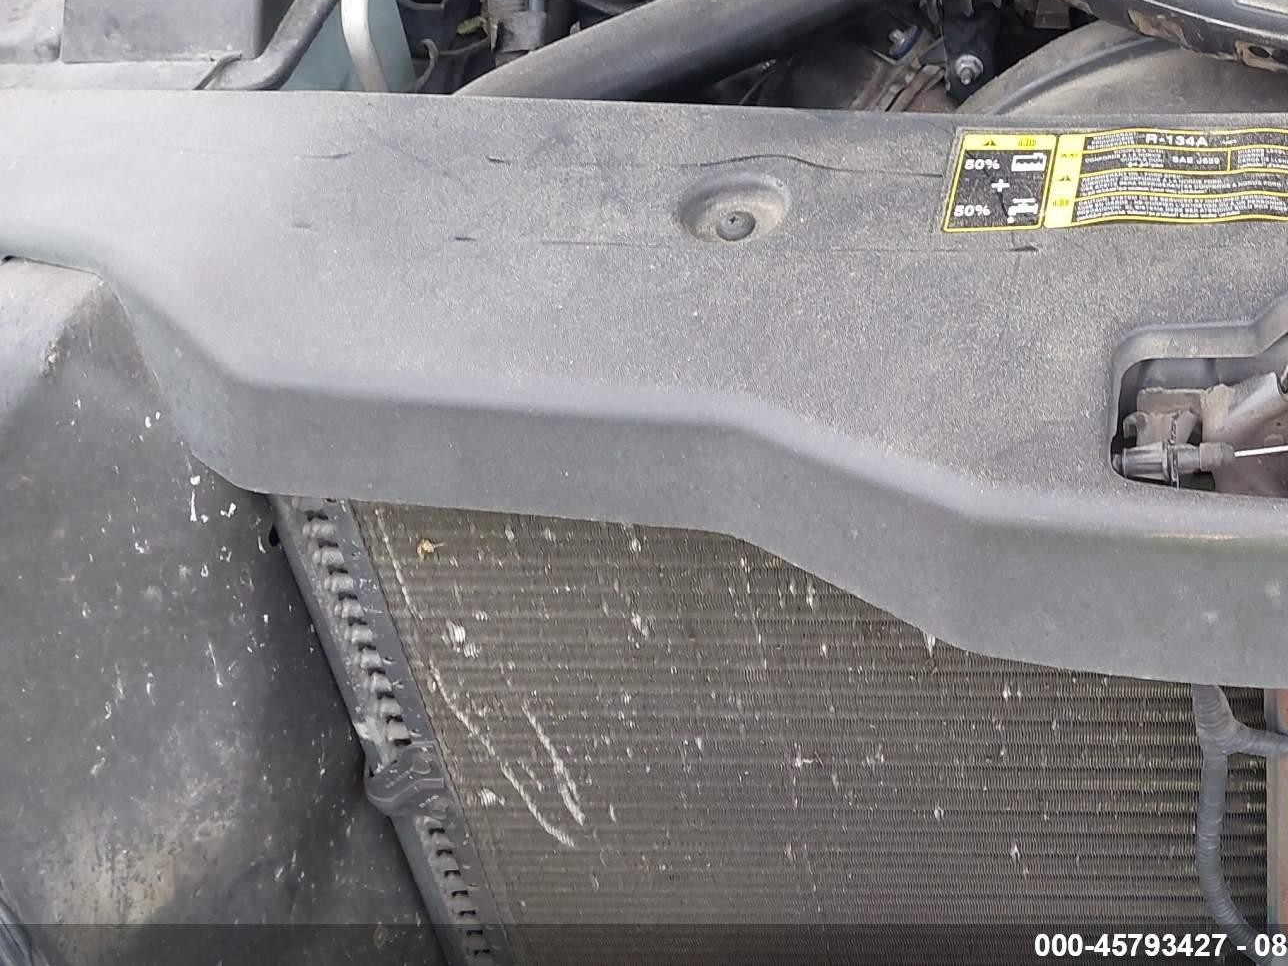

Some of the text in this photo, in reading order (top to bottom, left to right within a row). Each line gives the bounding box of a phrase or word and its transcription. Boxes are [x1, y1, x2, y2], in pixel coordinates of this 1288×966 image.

[1145, 133, 1209, 147] R-134A
[964, 158, 1000, 171] 50%
[953, 204, 991, 218] 50%
